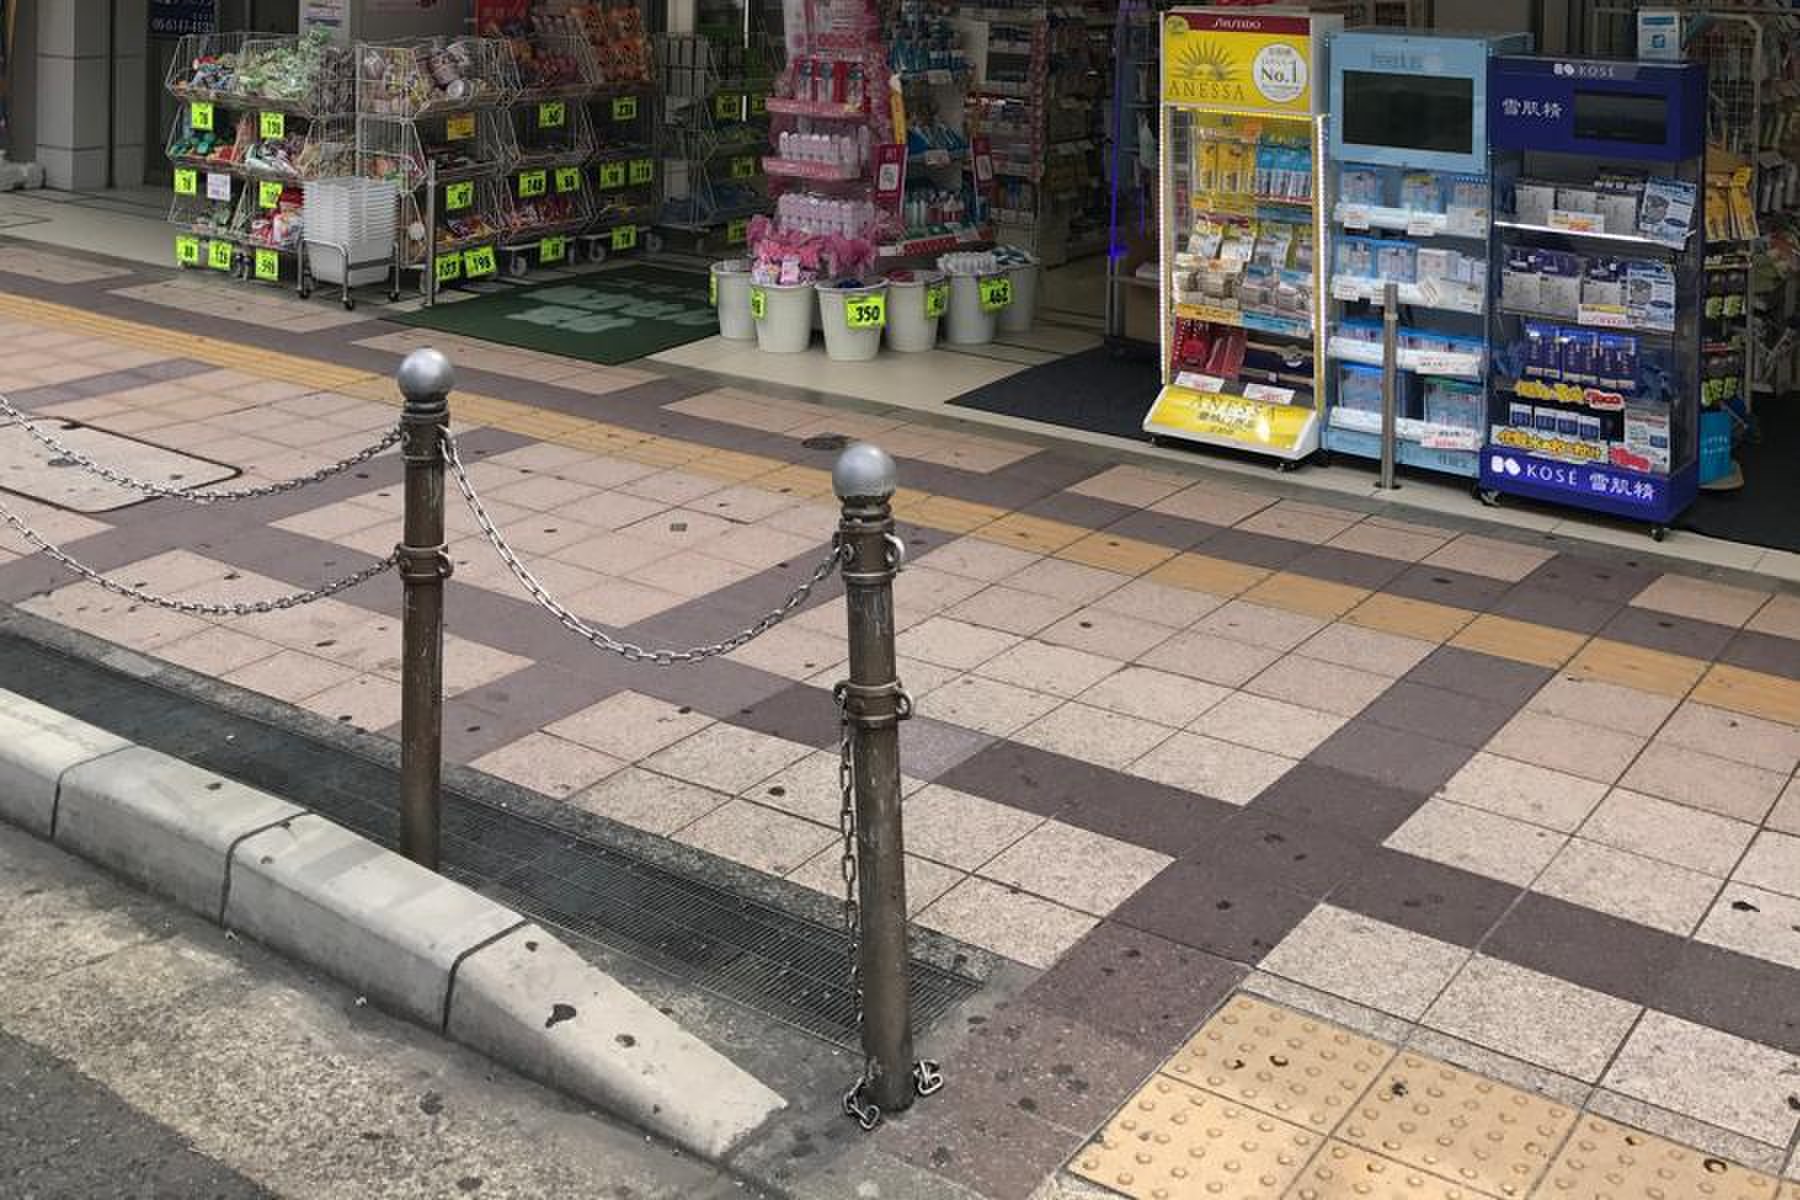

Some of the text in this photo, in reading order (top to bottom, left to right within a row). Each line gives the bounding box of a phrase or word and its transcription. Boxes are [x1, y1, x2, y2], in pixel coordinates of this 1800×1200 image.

[1260, 58, 1298, 83] No.1
[1167, 79, 1245, 100] ANESSA
[854, 305, 881, 323] 350
[1588, 472, 1655, 501] 雪肌精
